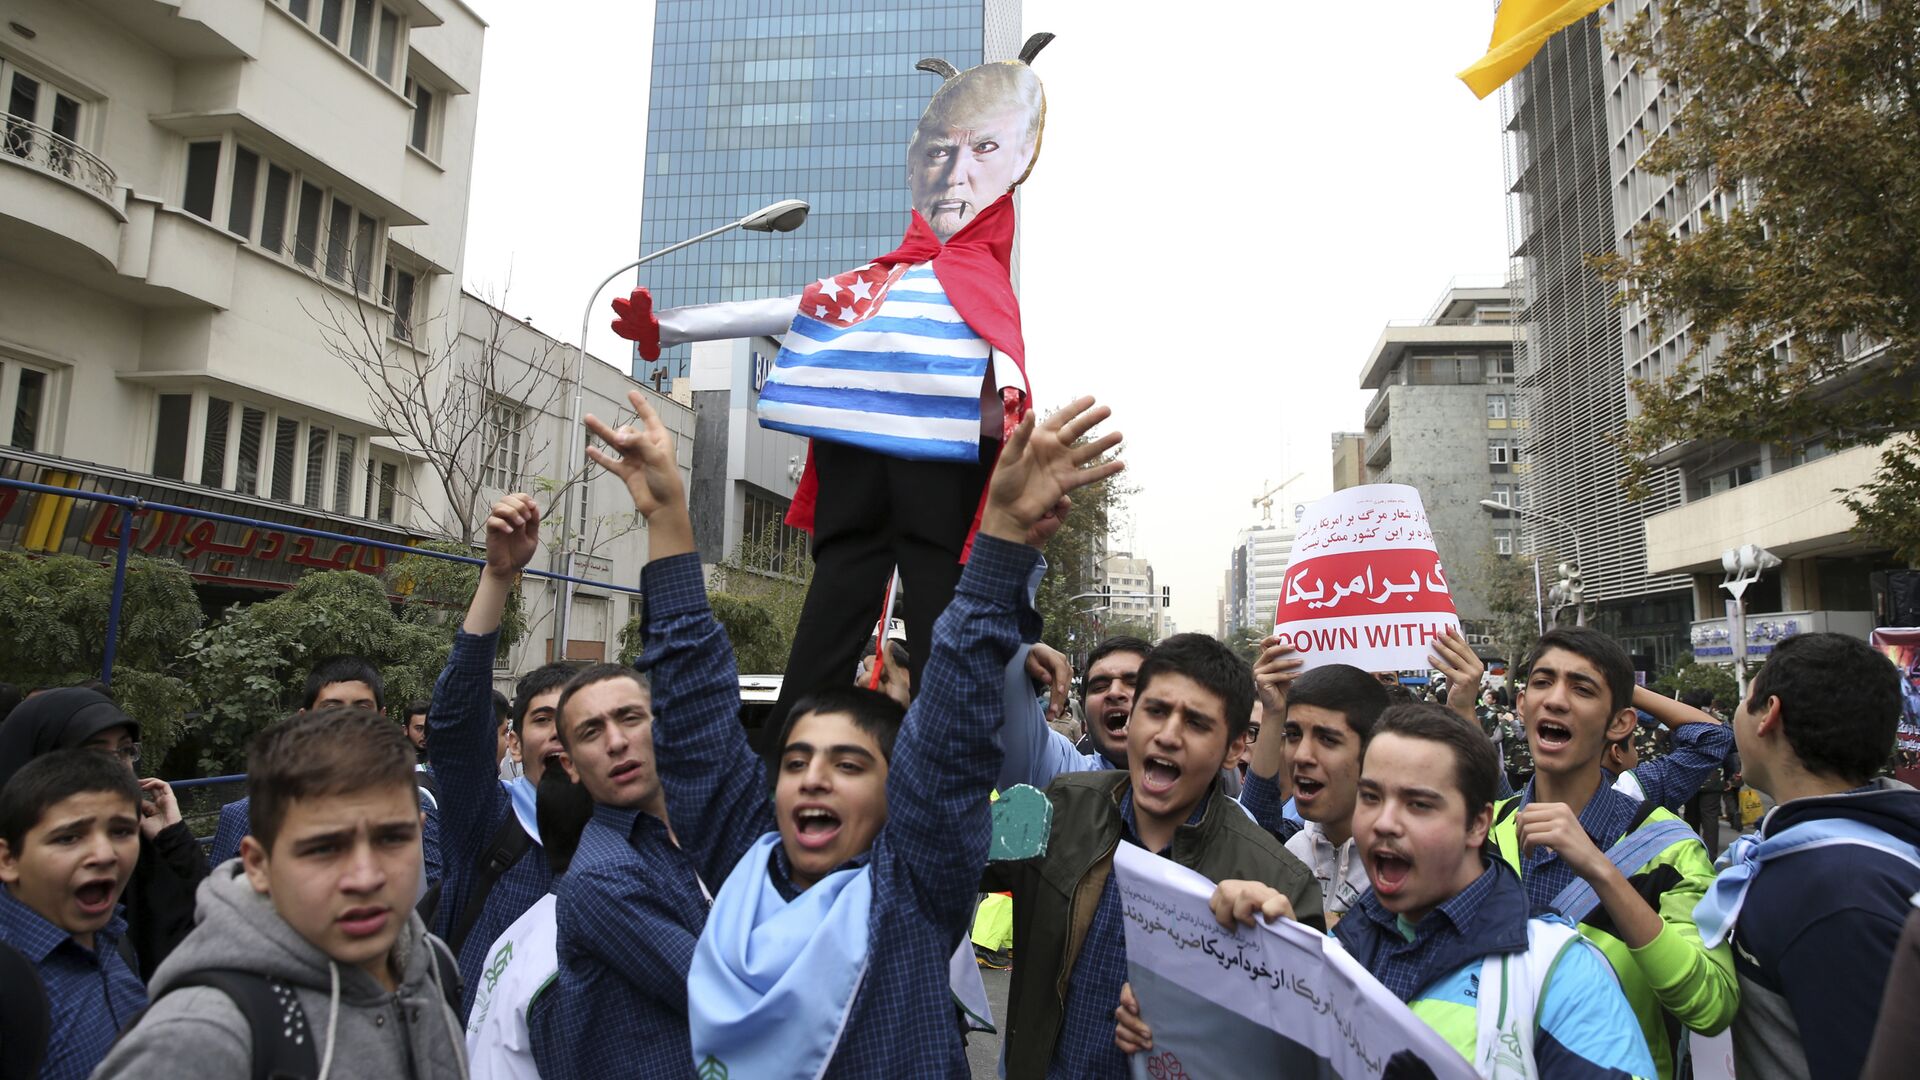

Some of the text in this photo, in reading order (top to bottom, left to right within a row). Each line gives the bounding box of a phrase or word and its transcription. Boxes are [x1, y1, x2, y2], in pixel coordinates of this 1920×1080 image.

[1357, 508, 1387, 524] مرگ
[1391, 508, 1411, 521] شعار
[1321, 532, 1348, 548] ممکن
[1351, 526, 1380, 543] کشور
[1384, 526, 1403, 542] این
[1364, 622, 1438, 649] WITH
[1122, 904, 1167, 934] خوردند
[1167, 928, 1201, 949] ضربه
[1201, 934, 1244, 970] آمریکا
[1243, 960, 1272, 981] خود
[1270, 968, 1285, 989] از
